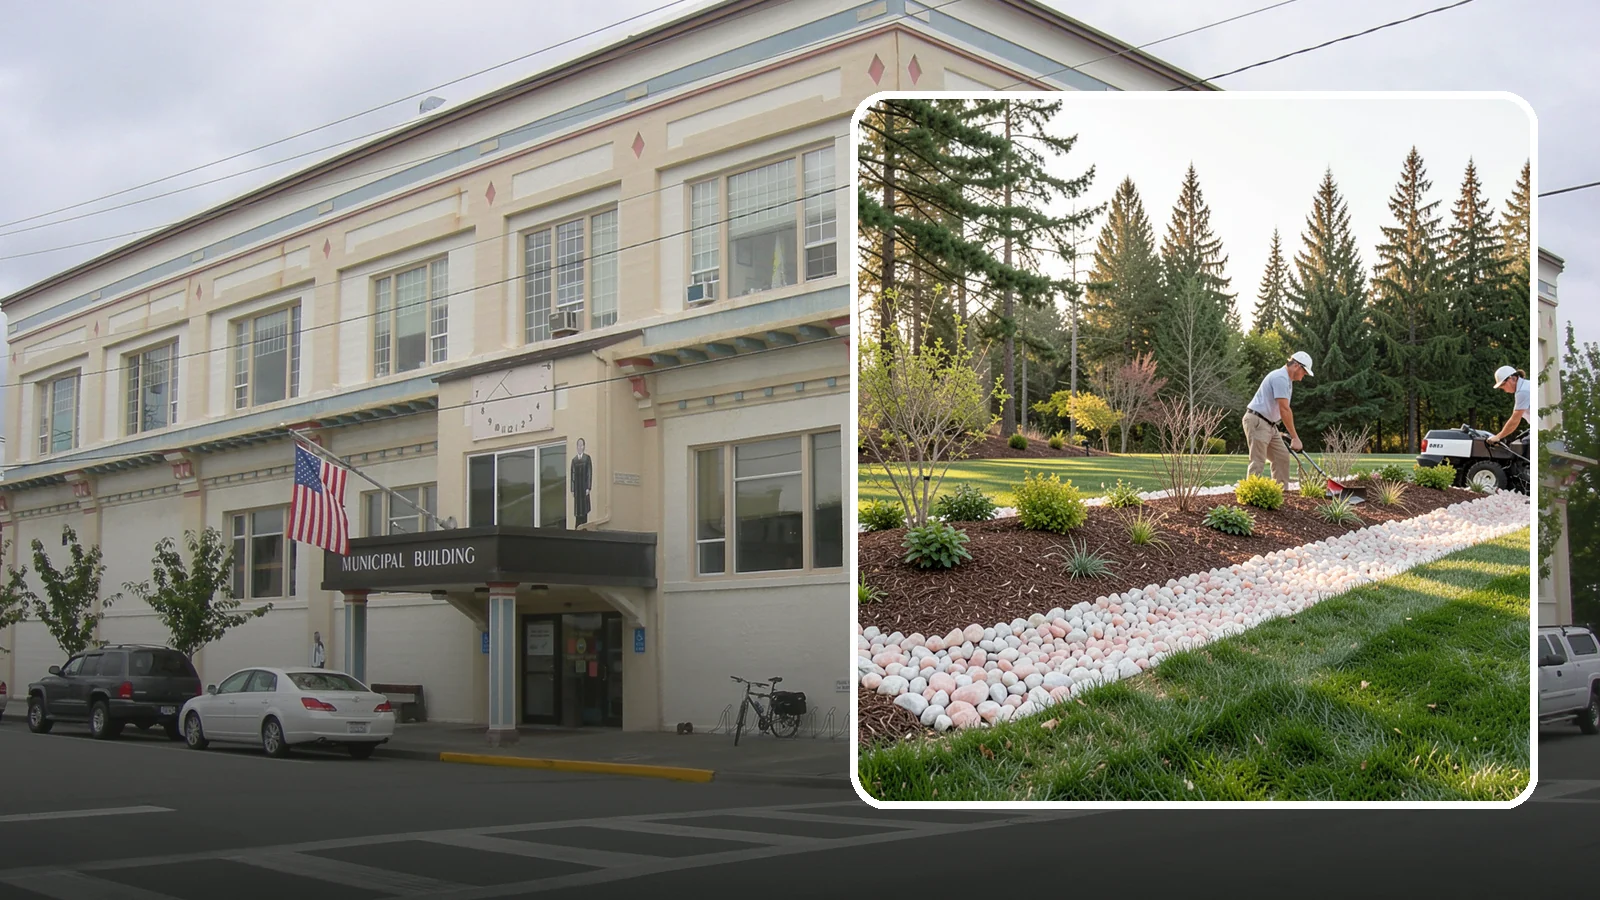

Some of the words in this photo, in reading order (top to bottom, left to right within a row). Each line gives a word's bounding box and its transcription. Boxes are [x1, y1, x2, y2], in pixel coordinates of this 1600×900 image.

[535, 402, 540, 410] 4
[480, 407, 485, 415] 8
[487, 418, 493, 426] 9
[528, 414, 533, 422] 3
[494, 423, 500, 432] 10
[521, 420, 526, 428] 2
[507, 425, 513, 433] 12
[342, 553, 405, 572] MUNICIPAL
[414, 546, 475, 567] BUILDING
